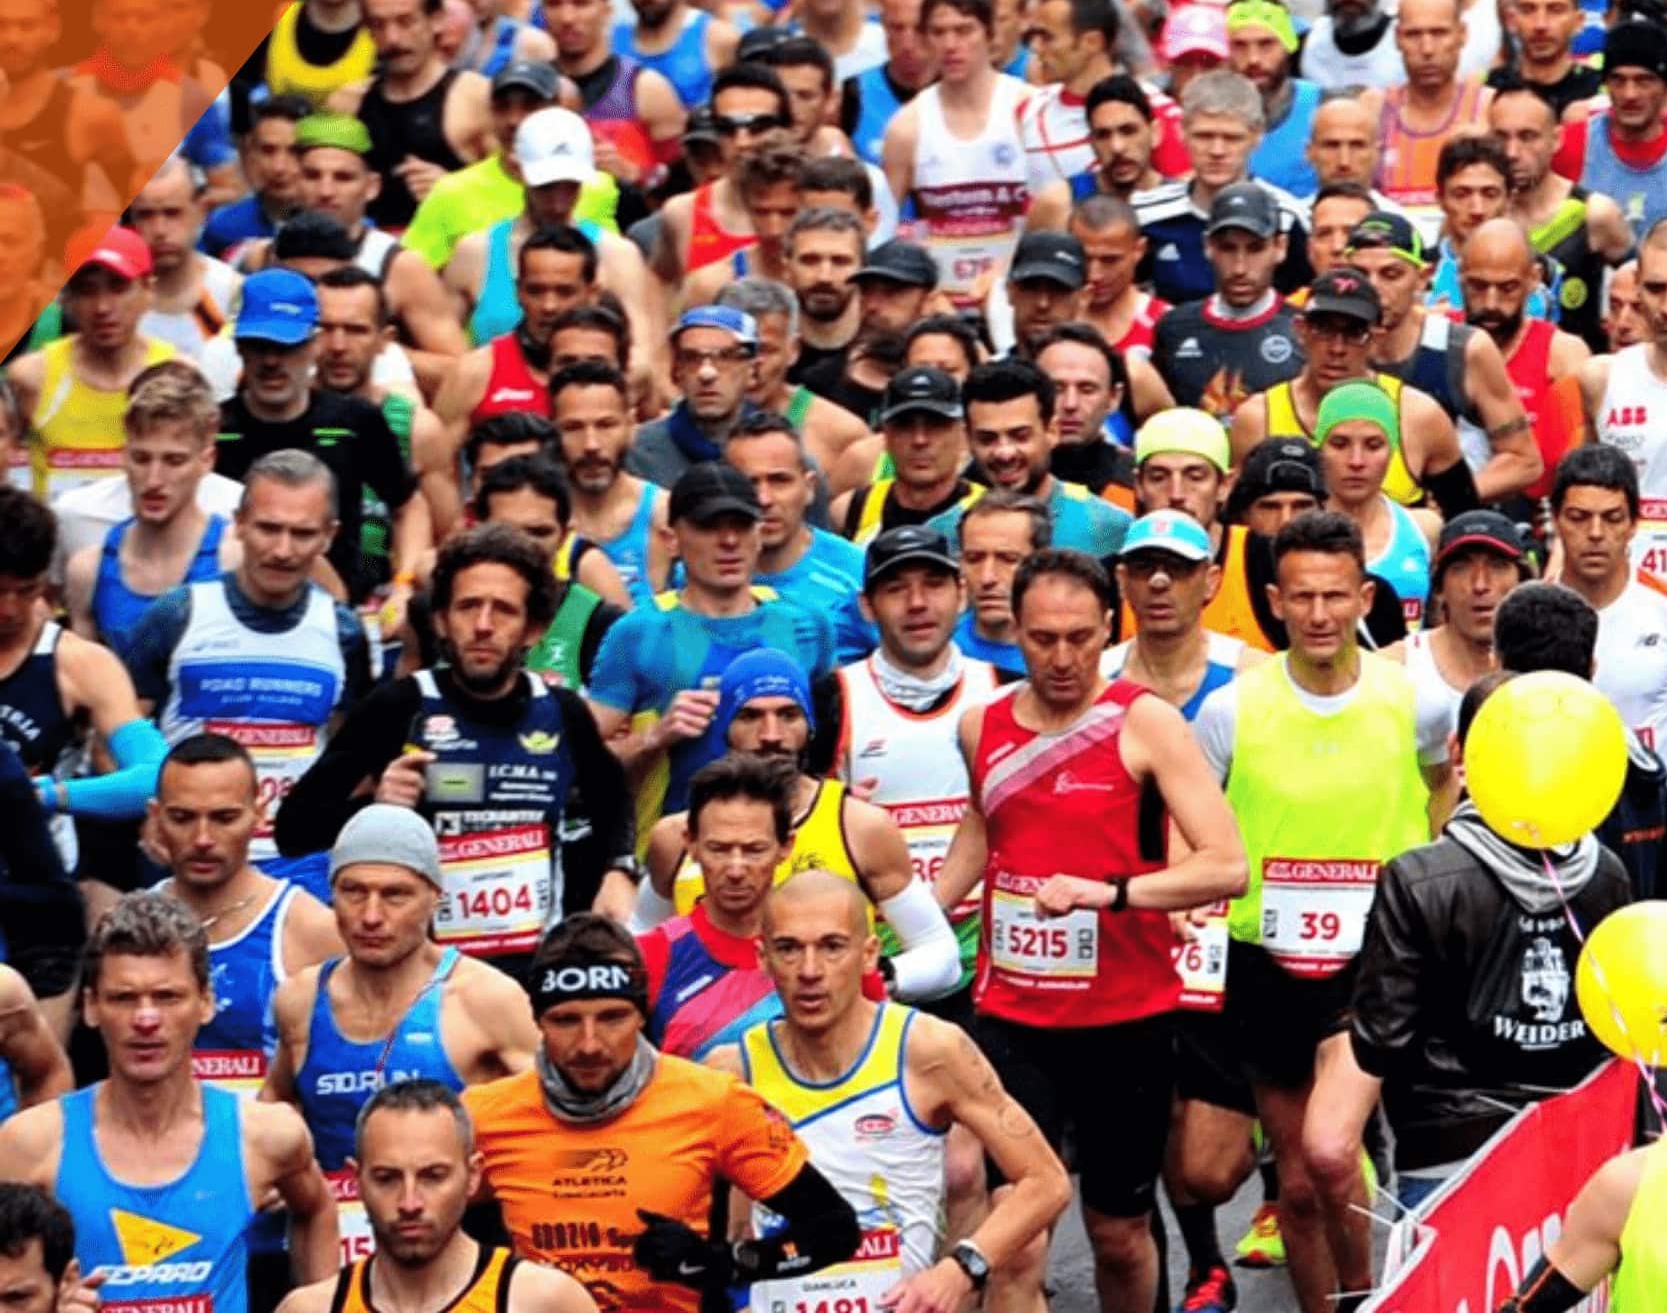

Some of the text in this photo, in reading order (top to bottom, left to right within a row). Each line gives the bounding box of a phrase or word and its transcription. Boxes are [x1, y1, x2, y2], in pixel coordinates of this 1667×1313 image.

[1606, 405, 1647, 427] ABB
[458, 827, 547, 858] GENERALI
[1292, 861, 1378, 882] GENERALI
[456, 884, 533, 919] 1404
[1299, 912, 1342, 942] 39
[1009, 926, 1068, 960] 5215
[1494, 1014, 1586, 1046] WEIDER
[191, 1055, 260, 1079] NERALI
